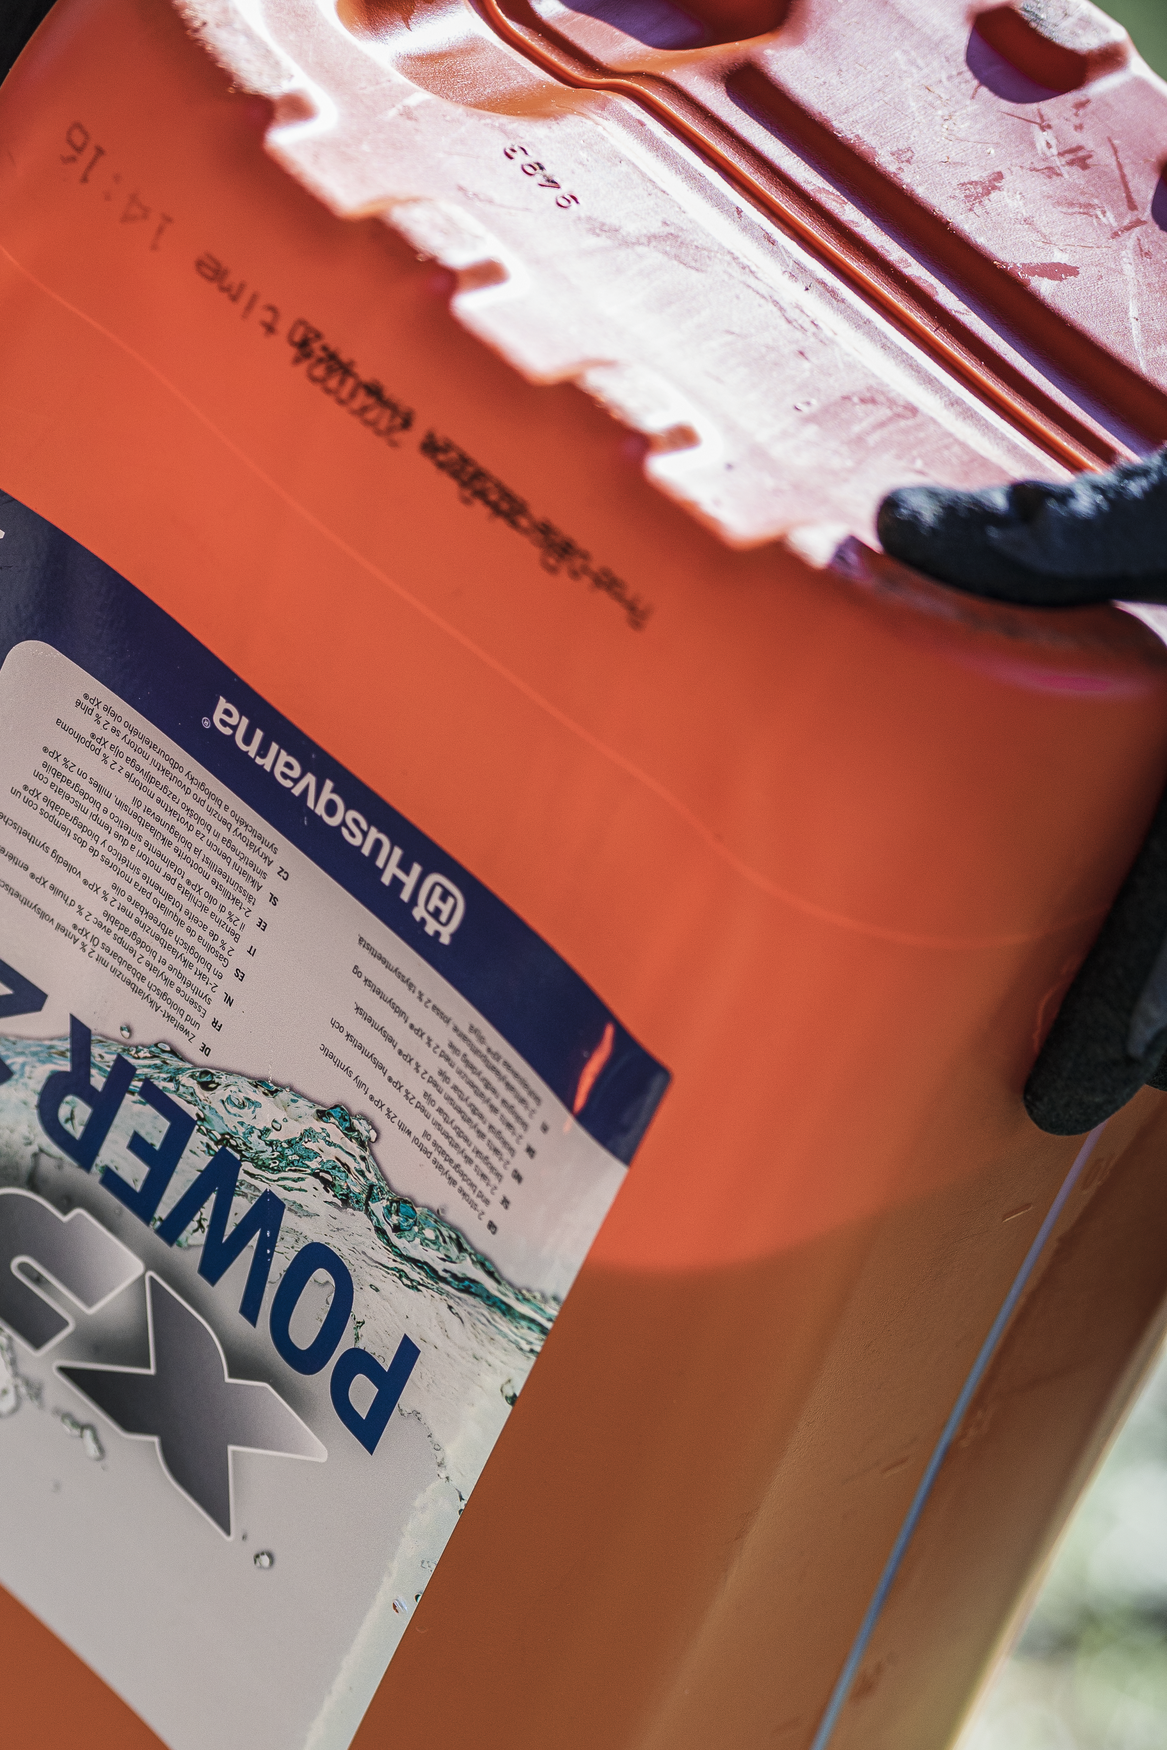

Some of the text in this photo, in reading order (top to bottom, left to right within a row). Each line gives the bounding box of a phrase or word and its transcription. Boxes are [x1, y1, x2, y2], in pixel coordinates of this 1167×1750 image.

[60, 120, 279, 335] time 14:16
[93, 713, 101, 724] %
[102, 704, 122, 722] oleje
[102, 719, 109, 730] 2
[110, 725, 121, 737] se
[109, 743, 124, 758] olja
[121, 734, 150, 760] motory
[61, 757, 76, 772] 2%
[76, 767, 87, 779] on
[88, 777, 112, 798] milles
[184, 770, 222, 808] biologicky
[192, 792, 206, 807] pro
[55, 718, 278, 906] SL Alkilatni bencin za dvotaktne motorje z 2 % popolnoma
[102, 806, 108, 814] e
[109, 812, 142, 842] sintetico
[142, 804, 192, 851] biolagunevat
[212, 829, 220, 840] in
[100, 839, 107, 847] y
[143, 839, 185, 879] totalmente
[193, 846, 202, 858] ja
[32, 769, 256, 956] IT Benzina alchilata per motori a due tempi miscelata con
[50, 848, 81, 878] volledig
[173, 845, 210, 880] mootorite
[276, 866, 289, 880] CZ
[10, 786, 245, 981] ES Gasolina de alquilato para motores de dos tiempos con un
[141, 872, 182, 911] totalmente
[101, 889, 109, 901] %
[109, 896, 117, 907] 2
[203, 890, 217, 905] olio
[210, 877, 251, 917] 2-taktiliste
[76, 904, 84, 916] %
[117, 902, 133, 918] met
[217, 903, 226, 912] di
[84, 911, 92, 921] 2
[183, 908, 208, 931] aceite
[226, 910, 239, 926] 2%
[255, 917, 267, 931] EE
[54, 922, 79, 944] Anteil
[92, 917, 112, 935] avec
[111, 882, 223, 979] en biologisch afbreekbare olie
[239, 922, 245, 931] il
[208, 929, 219, 941] de
[79, 941, 87, 952] %
[112, 933, 136, 957] temps
[219, 939, 226, 950] %
[227, 946, 234, 956] 2
[87, 948, 95, 958] 2
[95, 953, 109, 967] mit
[136, 953, 144, 963] 2
[158, 955, 166, 965] et
[100, 942, 146, 983] abbaubares
[144, 959, 174, 988] alkylate
[193, 967, 218, 992] 2-takt
[146, 980, 184, 1018] biologisch
[175, 986, 206, 1018] Essence
[223, 991, 233, 1006] NL
[184, 1014, 200, 1030] und
[211, 1017, 222, 1031] FR
[199, 1041, 211, 1056] DE
[319, 1043, 353, 1077] synthetic
[352, 1075, 369, 1094] fully
[381, 1107, 397, 1123] 2%
[397, 1119, 412, 1137] with
[421, 1129, 431, 1141] oil
[411, 1135, 432, 1158] petrol
[431, 1157, 457, 1187] alkylate
[457, 1186, 485, 1220] 2-stroke
[29, 1013, 422, 1453] POWER
